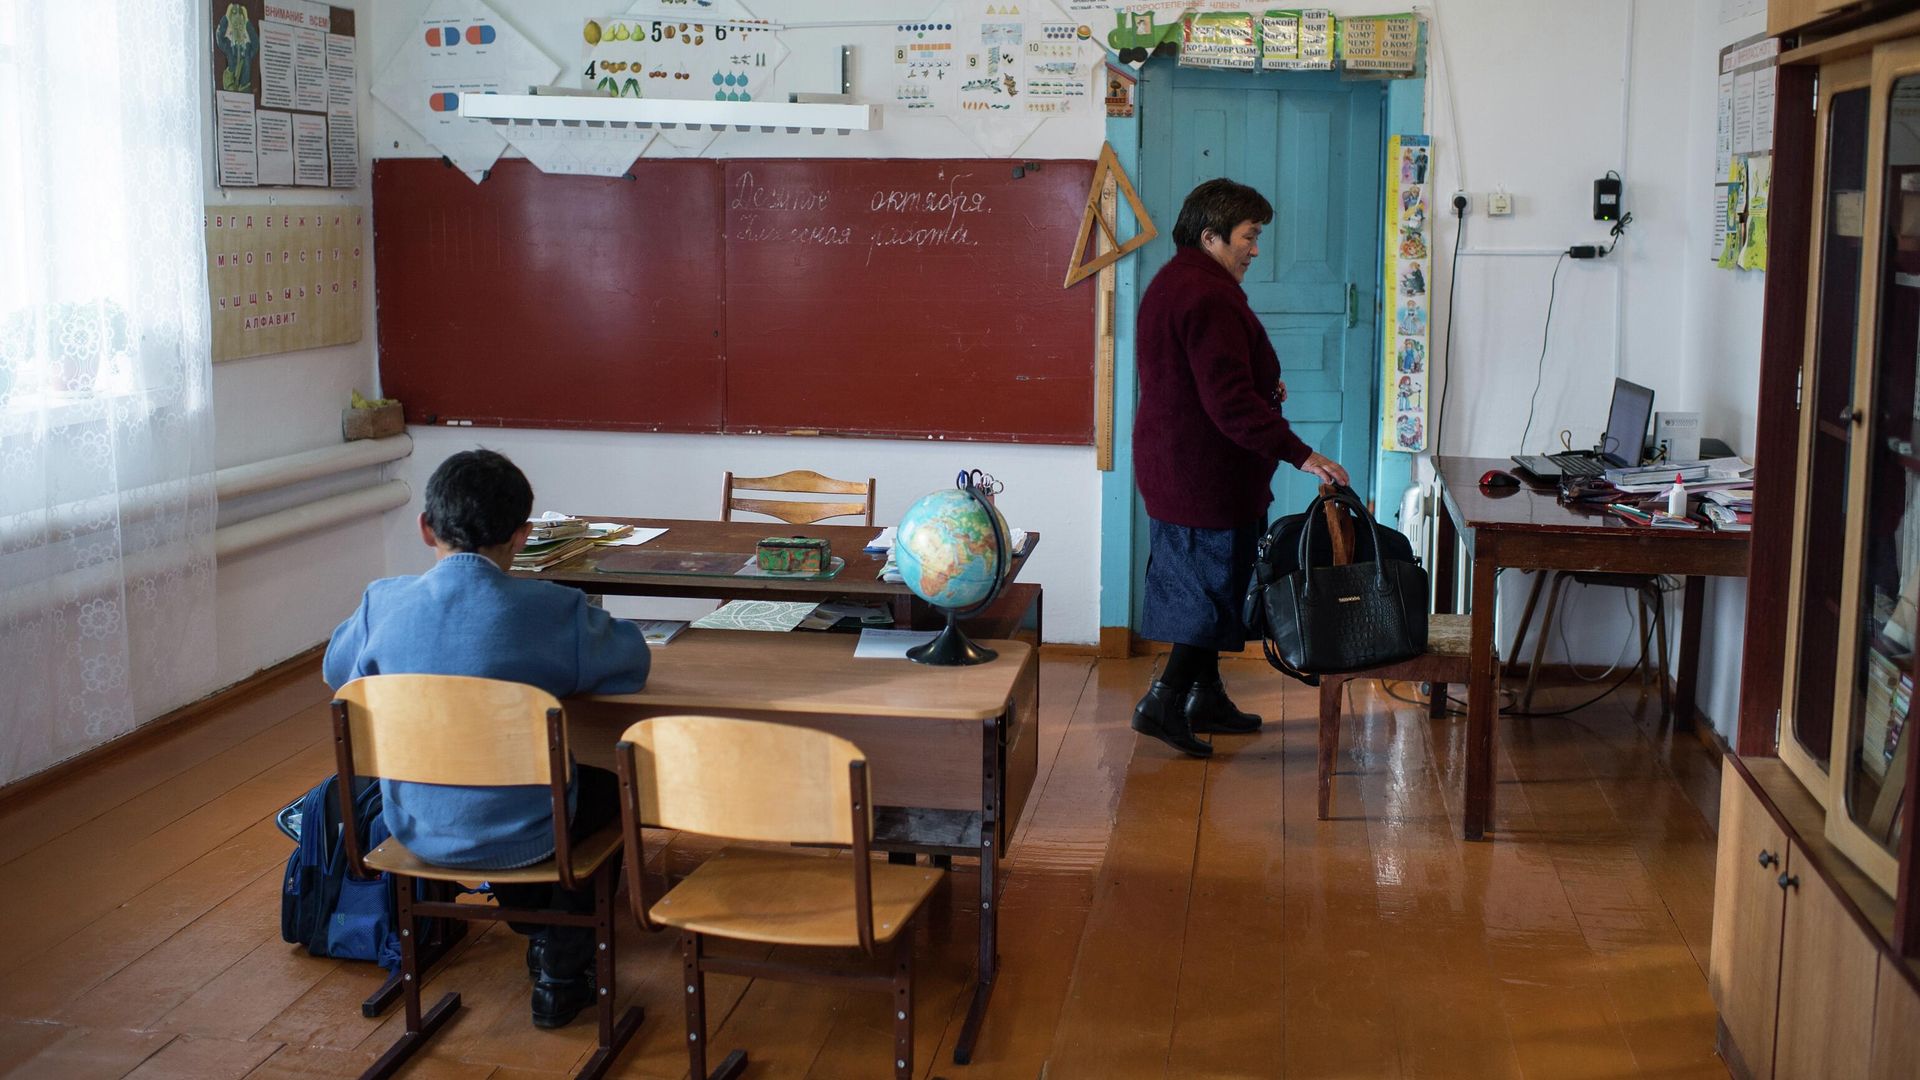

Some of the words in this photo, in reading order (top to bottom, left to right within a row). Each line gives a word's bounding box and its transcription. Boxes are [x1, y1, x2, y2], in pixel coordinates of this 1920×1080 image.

[1210, 1, 1241, 9] ЧЛЕНЫ
[265, 5, 304, 23] ВНИМАНИЕ
[309, 15, 329, 29] ВСЕМ
[1305, 11, 1326, 19] ЧЕЙ?
[651, 21, 662, 42] 5
[715, 26, 727, 41] 6
[1029, 43, 1039, 52] 10
[1265, 45, 1296, 53] КАКОЕ?
[1349, 47, 1375, 55] КОГО?
[897, 50, 904, 60] 8
[970, 57, 976, 67] 9
[1180, 56, 1254, 67] ОБСТОЯТЕЛЬСТВО
[1352, 60, 1408, 69] ДОПОЛНЕНИЕ
[585, 60, 596, 79] 4
[216, 216, 223, 228] В
[231, 217, 236, 228] Г
[246, 216, 253, 228] Д
[266, 216, 271, 228] Е
[284, 215, 289, 228] Ё
[299, 217, 305, 226] Ж
[334, 216, 340, 225] И
[218, 255, 225, 266] М
[232, 254, 238, 265] Н
[246, 253, 253, 264] О
[266, 252, 271, 263] П
[284, 252, 289, 262] Р
[300, 251, 305, 262] С
[317, 250, 322, 260] Т
[334, 249, 339, 259] У
[354, 248, 360, 257] Ф
[220, 298, 226, 308] Ч
[233, 296, 241, 307] Ш
[250, 293, 257, 305] Щ
[266, 291, 273, 302] Ъ
[284, 289, 291, 299] Ы
[299, 287, 305, 297] Ь
[317, 285, 322, 295] Э
[332, 283, 339, 293] Ю
[352, 280, 358, 290] Я
[245, 312, 296, 330] АЛФАВИТ
